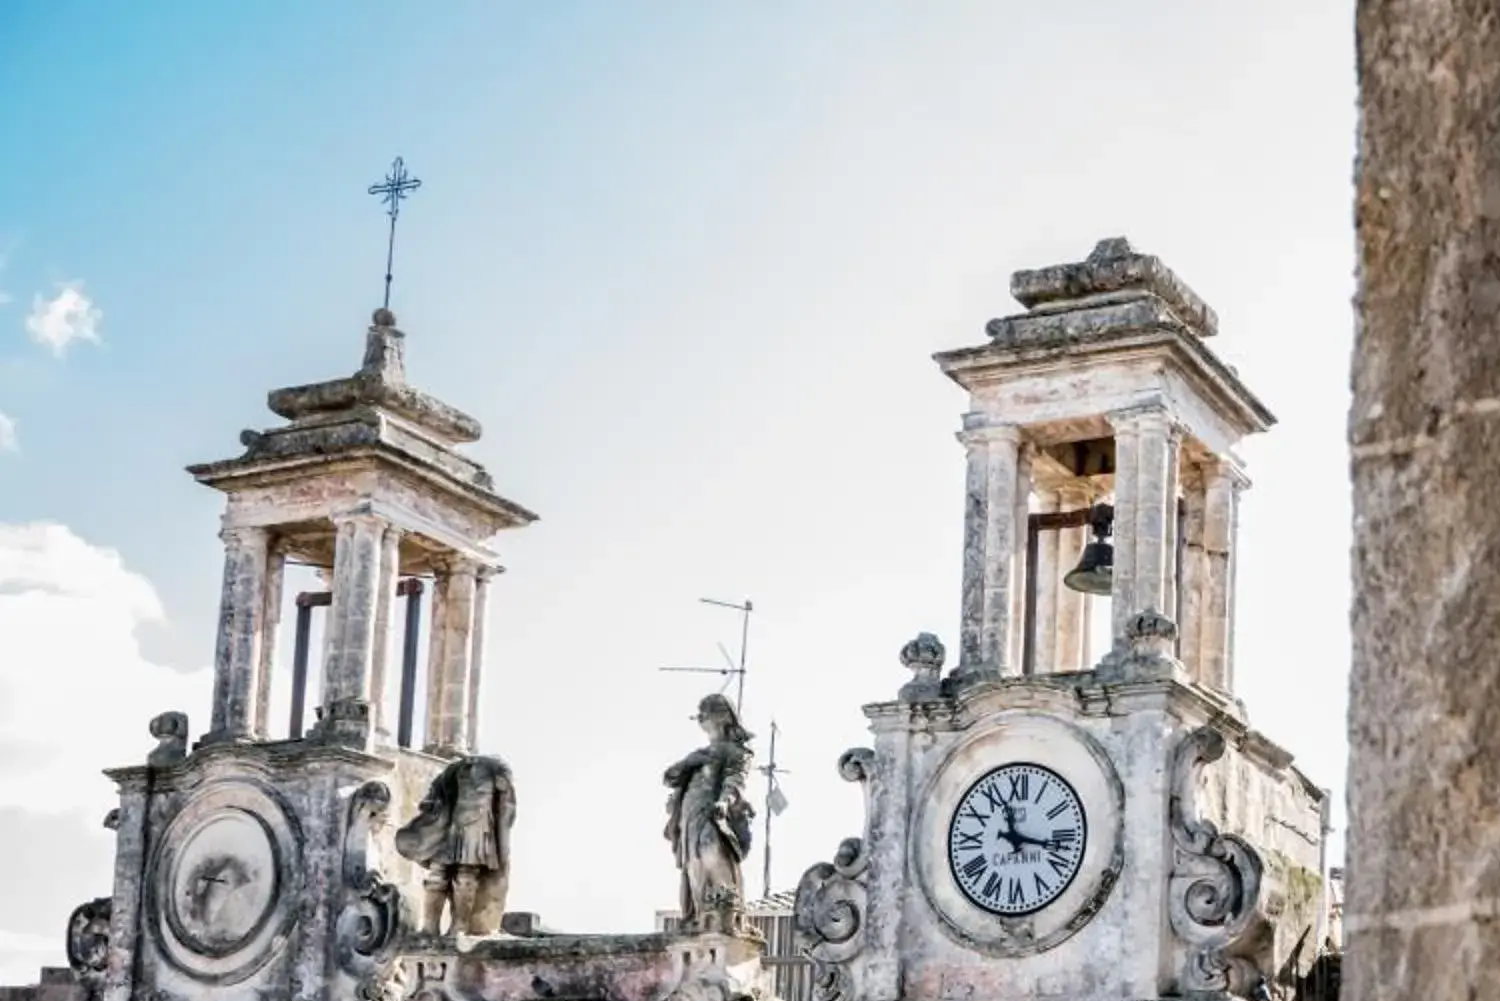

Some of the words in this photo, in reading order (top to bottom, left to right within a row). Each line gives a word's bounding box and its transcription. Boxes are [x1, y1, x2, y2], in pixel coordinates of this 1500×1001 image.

[982, 782, 1007, 813] XI
[1009, 774, 1028, 801] XII
[965, 804, 990, 827] X
[1046, 800, 1070, 820] II
[958, 832, 983, 850] IX
[1052, 829, 1075, 842] III
[1008, 877, 1024, 903] VI
[1034, 873, 1050, 896] V
